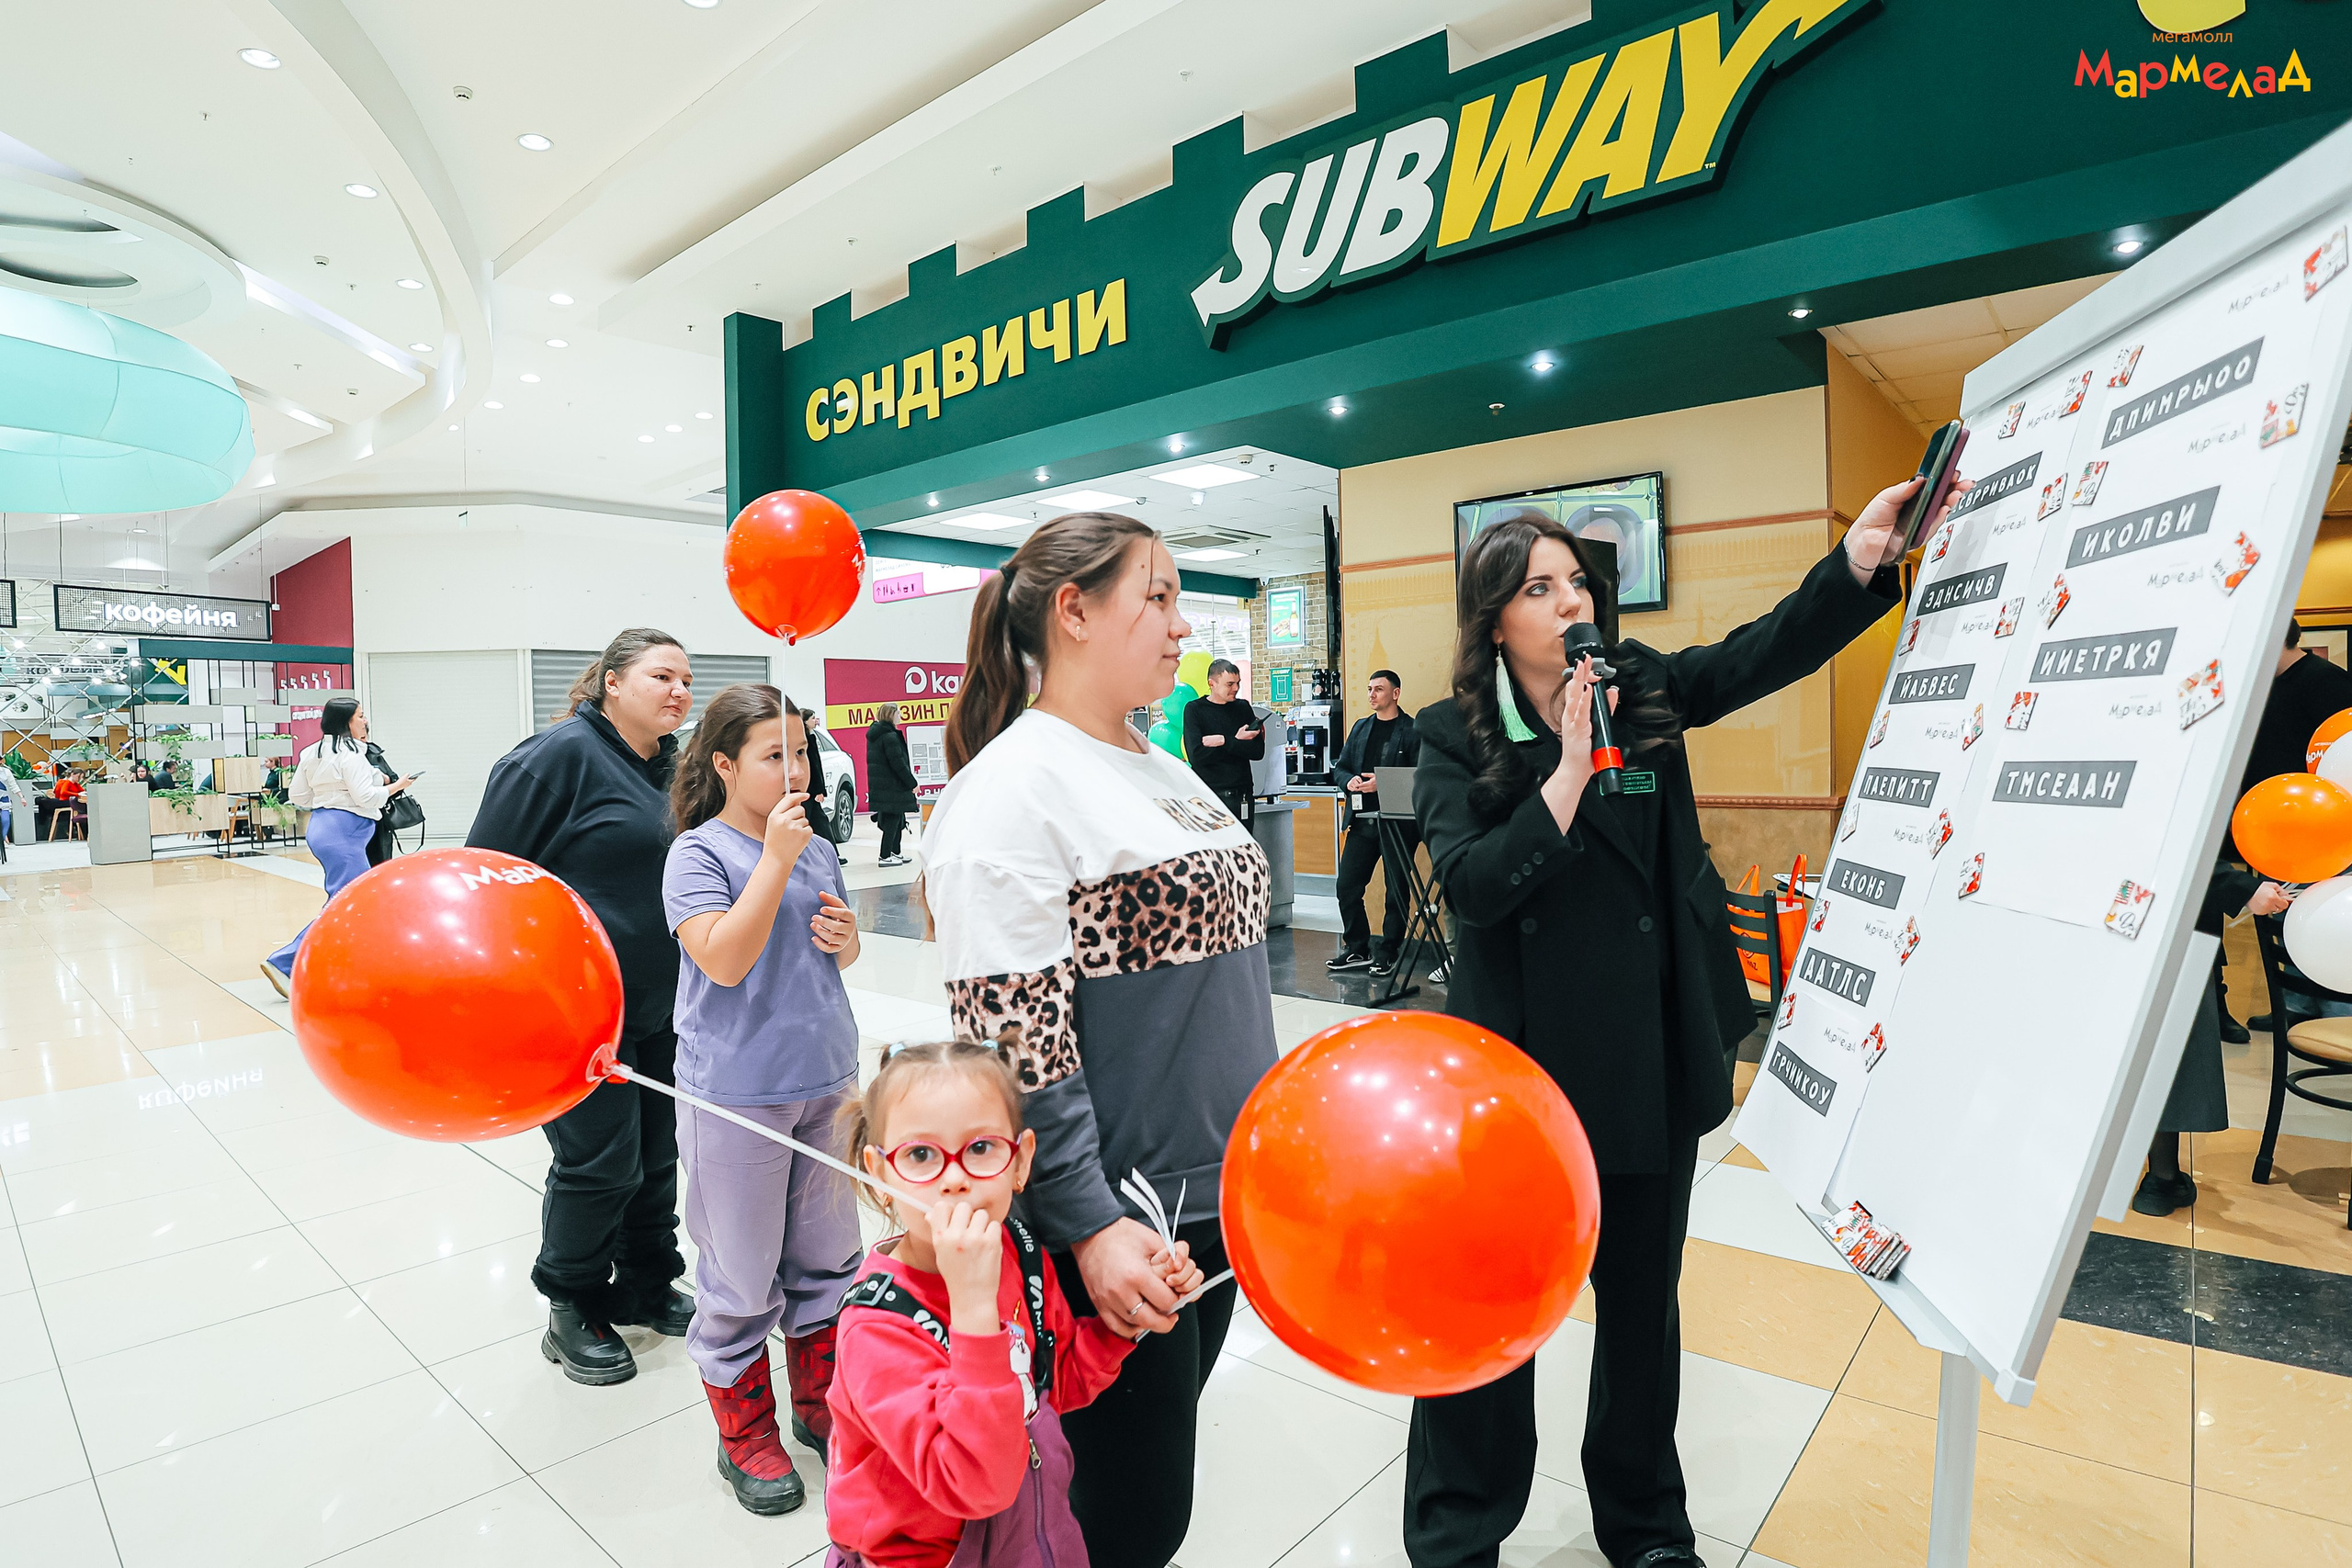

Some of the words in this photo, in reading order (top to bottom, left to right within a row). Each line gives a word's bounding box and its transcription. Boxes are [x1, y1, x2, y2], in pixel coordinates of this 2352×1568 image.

[1191, 0, 1849, 328] SUBWAY
[805, 277, 1127, 442] СЭНДВИЧИ
[2109, 355, 2251, 441] ДПИМРЫОО
[1951, 464, 2036, 513] СВРРИВАОК
[2081, 502, 2198, 558] ИКОЛВИ
[1925, 575, 1996, 609] ЭДНСИЧВ
[104, 602, 239, 628] кофейня
[2039, 639, 2162, 676] ИИЕТРКЯ
[1899, 673, 1959, 699] ЙАБВЕС
[848, 704, 934, 725] МАЗИН
[1863, 774, 1932, 801] ПАЕПИТТ
[2007, 770, 2124, 802] ТМСЕААН
[1840, 868, 1886, 901] ЕКОНБ
[1804, 953, 1869, 1003] ААТЛС
[1772, 1051, 1831, 1105] ГРЧИИКОУ
